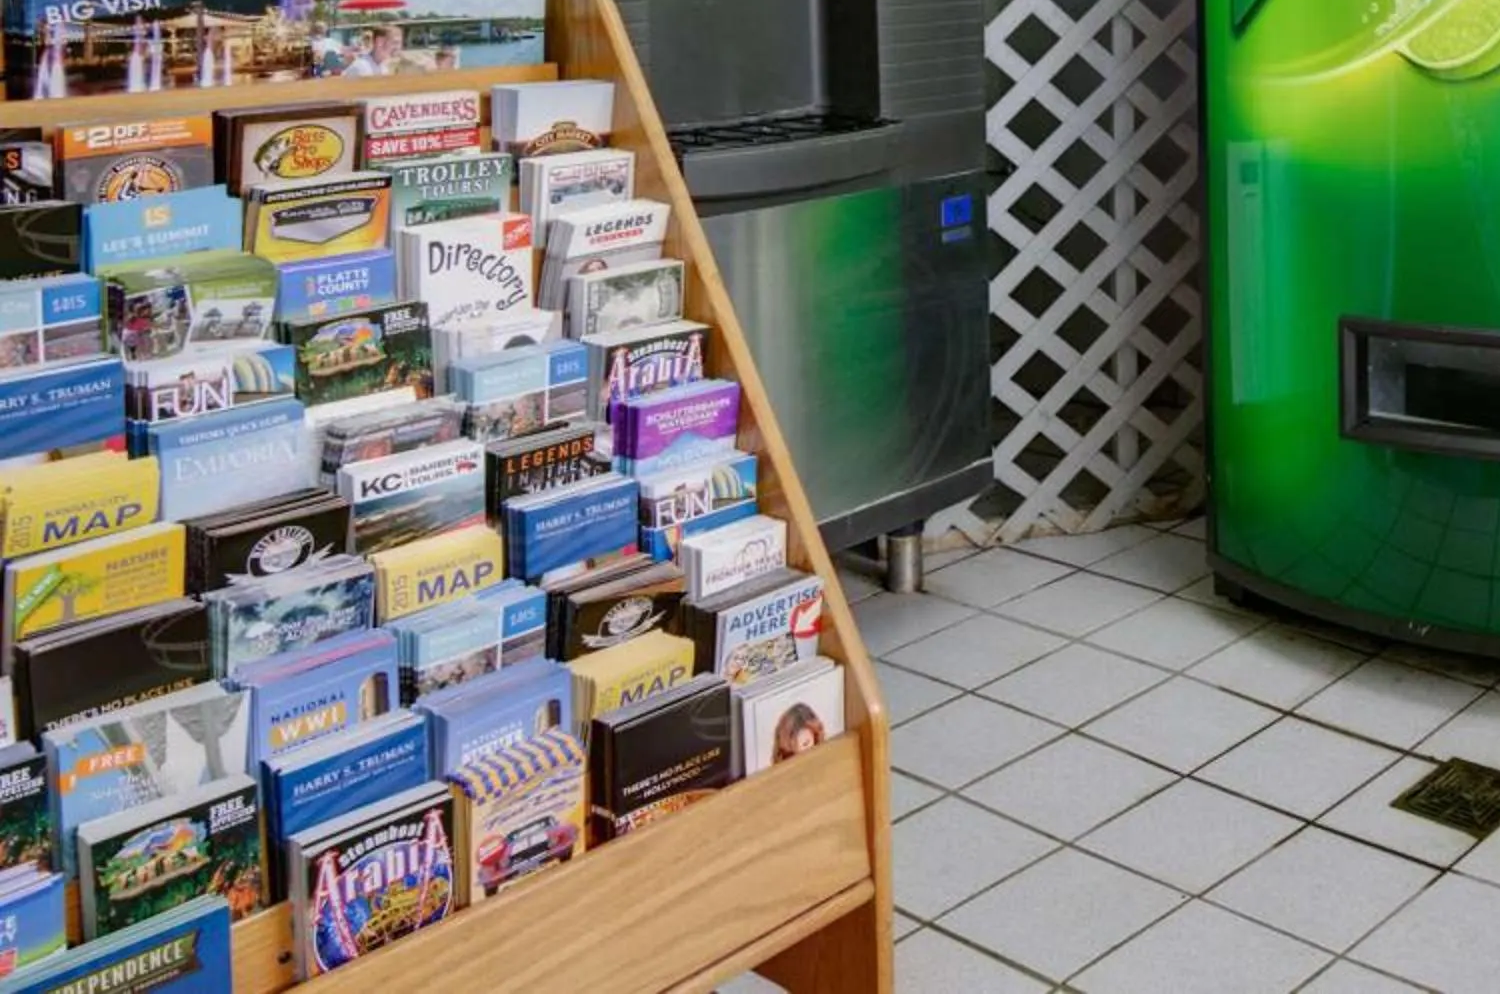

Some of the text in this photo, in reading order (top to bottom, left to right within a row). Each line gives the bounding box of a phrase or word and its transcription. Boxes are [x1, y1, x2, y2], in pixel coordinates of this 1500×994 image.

[370, 97, 478, 130] CAVENDER'S
[113, 121, 148, 139] OFF
[371, 139, 408, 155] SAVE
[400, 158, 505, 186] TROLLEY
[420, 179, 490, 199] TOURS!
[147, 224, 210, 244] SUMMIT
[585, 213, 654, 237] LEGENDS
[317, 268, 370, 284] PLATTE
[317, 279, 370, 295] COUNTY
[428, 240, 528, 311] Directory
[47, 379, 112, 400] TRUMAN
[152, 377, 228, 424] FUN
[174, 436, 297, 482] EMPORIA
[507, 436, 594, 475] LEGENDS
[547, 460, 579, 479] THE
[361, 472, 403, 498] KC
[410, 468, 454, 486] TOURS
[42, 502, 143, 543] MAP
[535, 513, 573, 532] HARRY
[585, 496, 632, 517] TRUMAN
[655, 486, 711, 528] FUN
[10, 514, 33, 553] 2015
[417, 560, 495, 604] MAP
[729, 585, 819, 632] ADVERTISE
[745, 616, 789, 640] HERE
[101, 699, 120, 715] NO
[124, 685, 165, 707] PLACE
[619, 666, 687, 707] MAP
[270, 690, 345, 725] NATIONAL
[278, 705, 340, 743] WWI
[86, 746, 139, 773] FREE
[292, 771, 342, 798] HARRY
[357, 740, 416, 770] TRUMAN
[210, 794, 244, 817] FREE
[338, 820, 425, 868] steamboat
